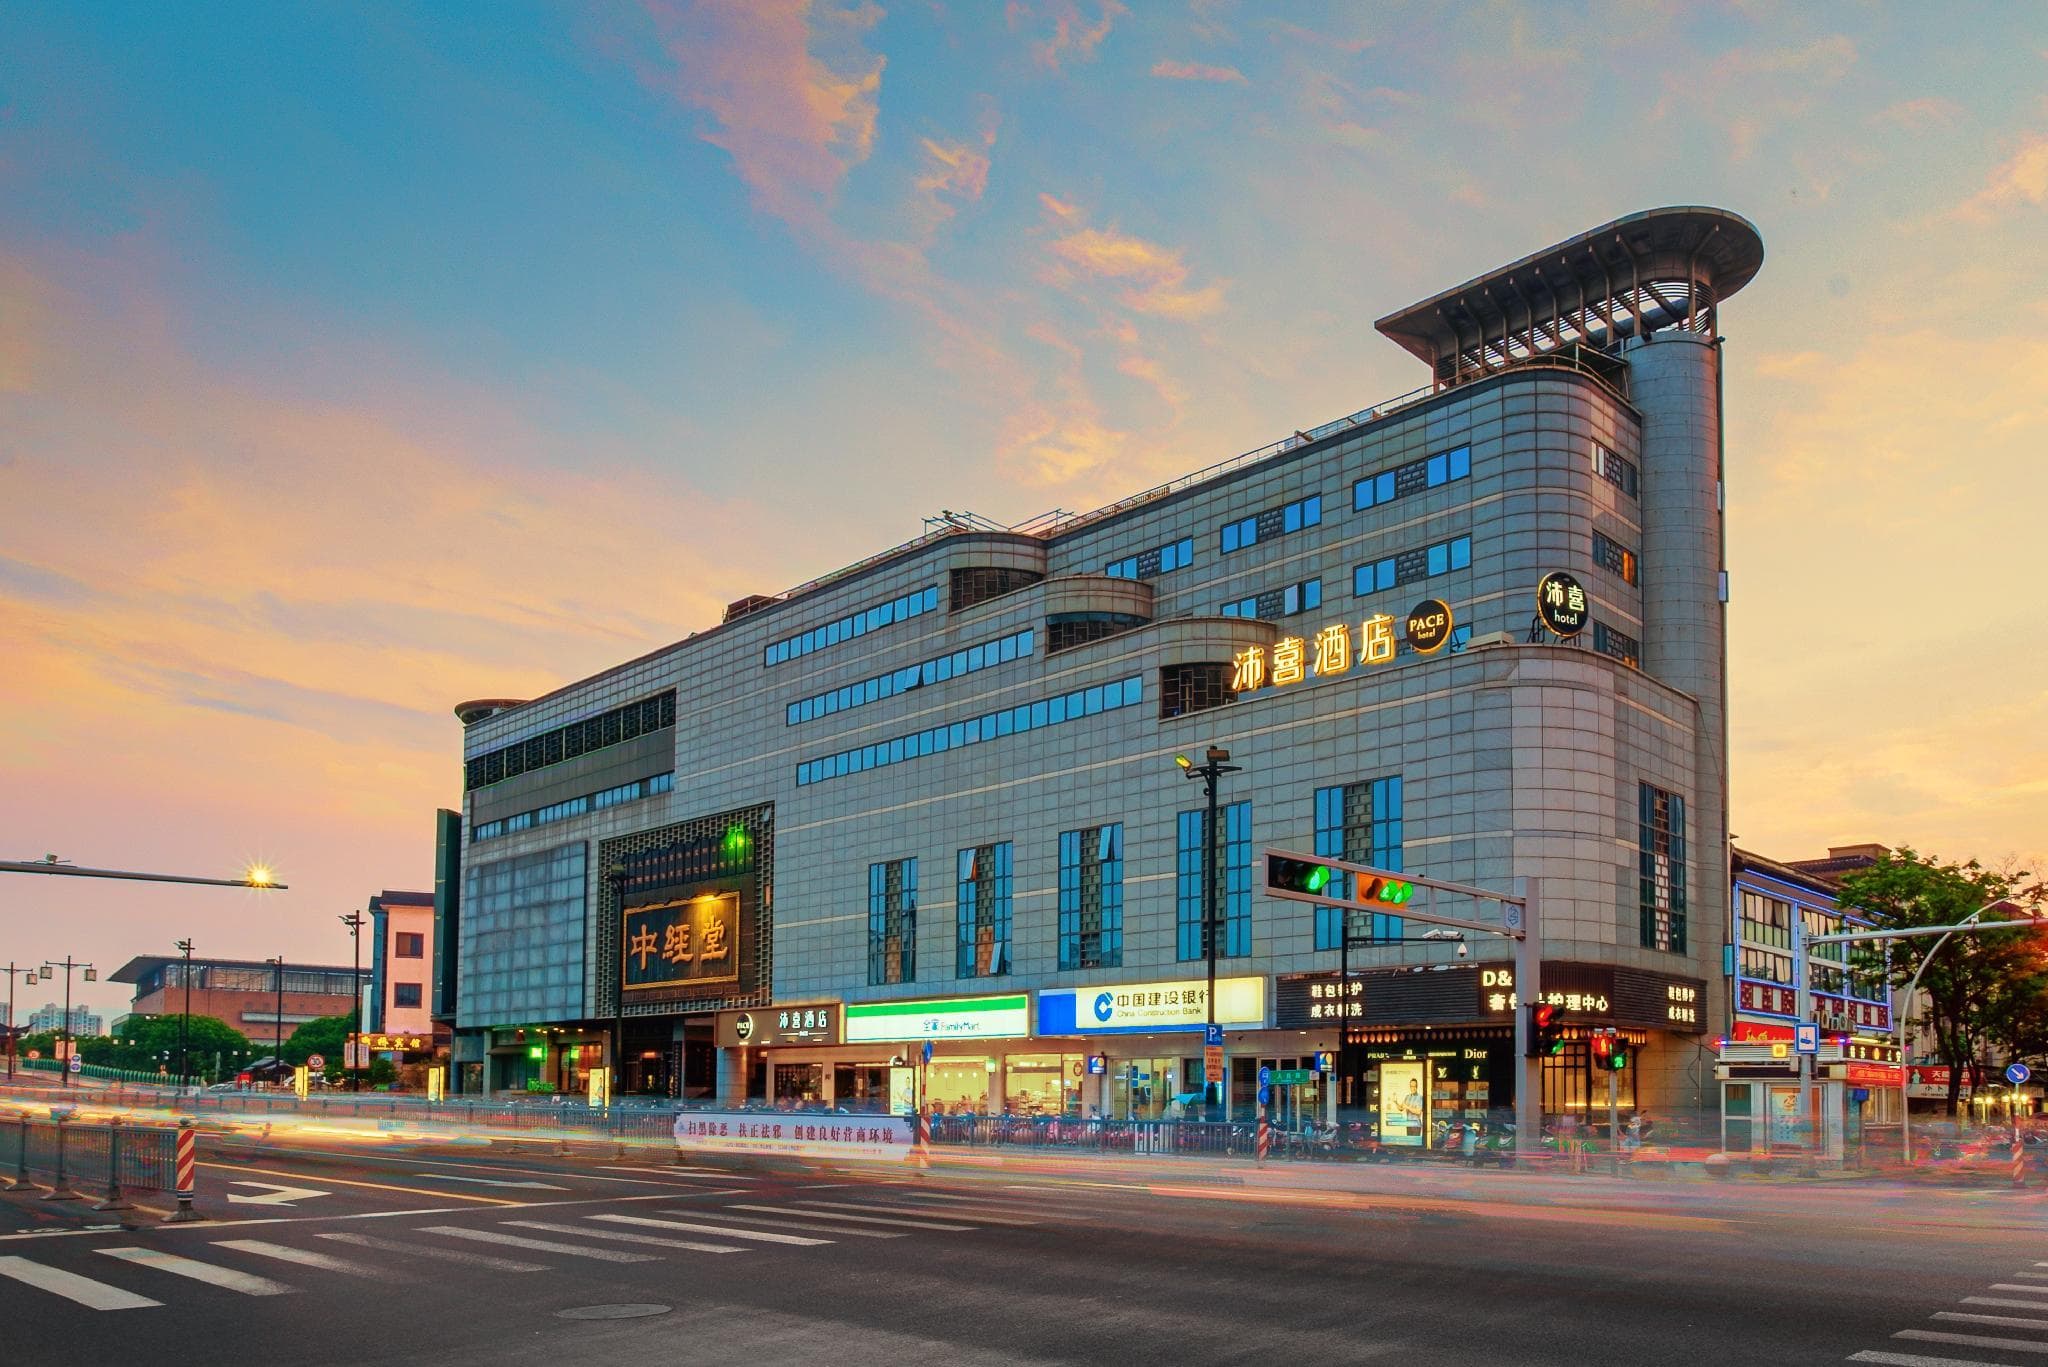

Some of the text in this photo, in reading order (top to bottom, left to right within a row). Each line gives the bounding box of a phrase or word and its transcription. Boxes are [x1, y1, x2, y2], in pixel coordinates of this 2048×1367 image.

[1546, 580, 1585, 612] 沛喜
[1409, 613, 1445, 632] PACE
[1554, 610, 1578, 625] hotel
[1417, 627, 1436, 640] hotel
[1232, 614, 1396, 691] 沛喜酒店
[1117, 1007, 1202, 1018] China Construction Bank
[1208, 1026, 1218, 1042] P
[1463, 1048, 1488, 1059] Dior
[688, 1120, 728, 1137] 扫黑除恶
[794, 1124, 893, 1144] 创建良好营商环境
